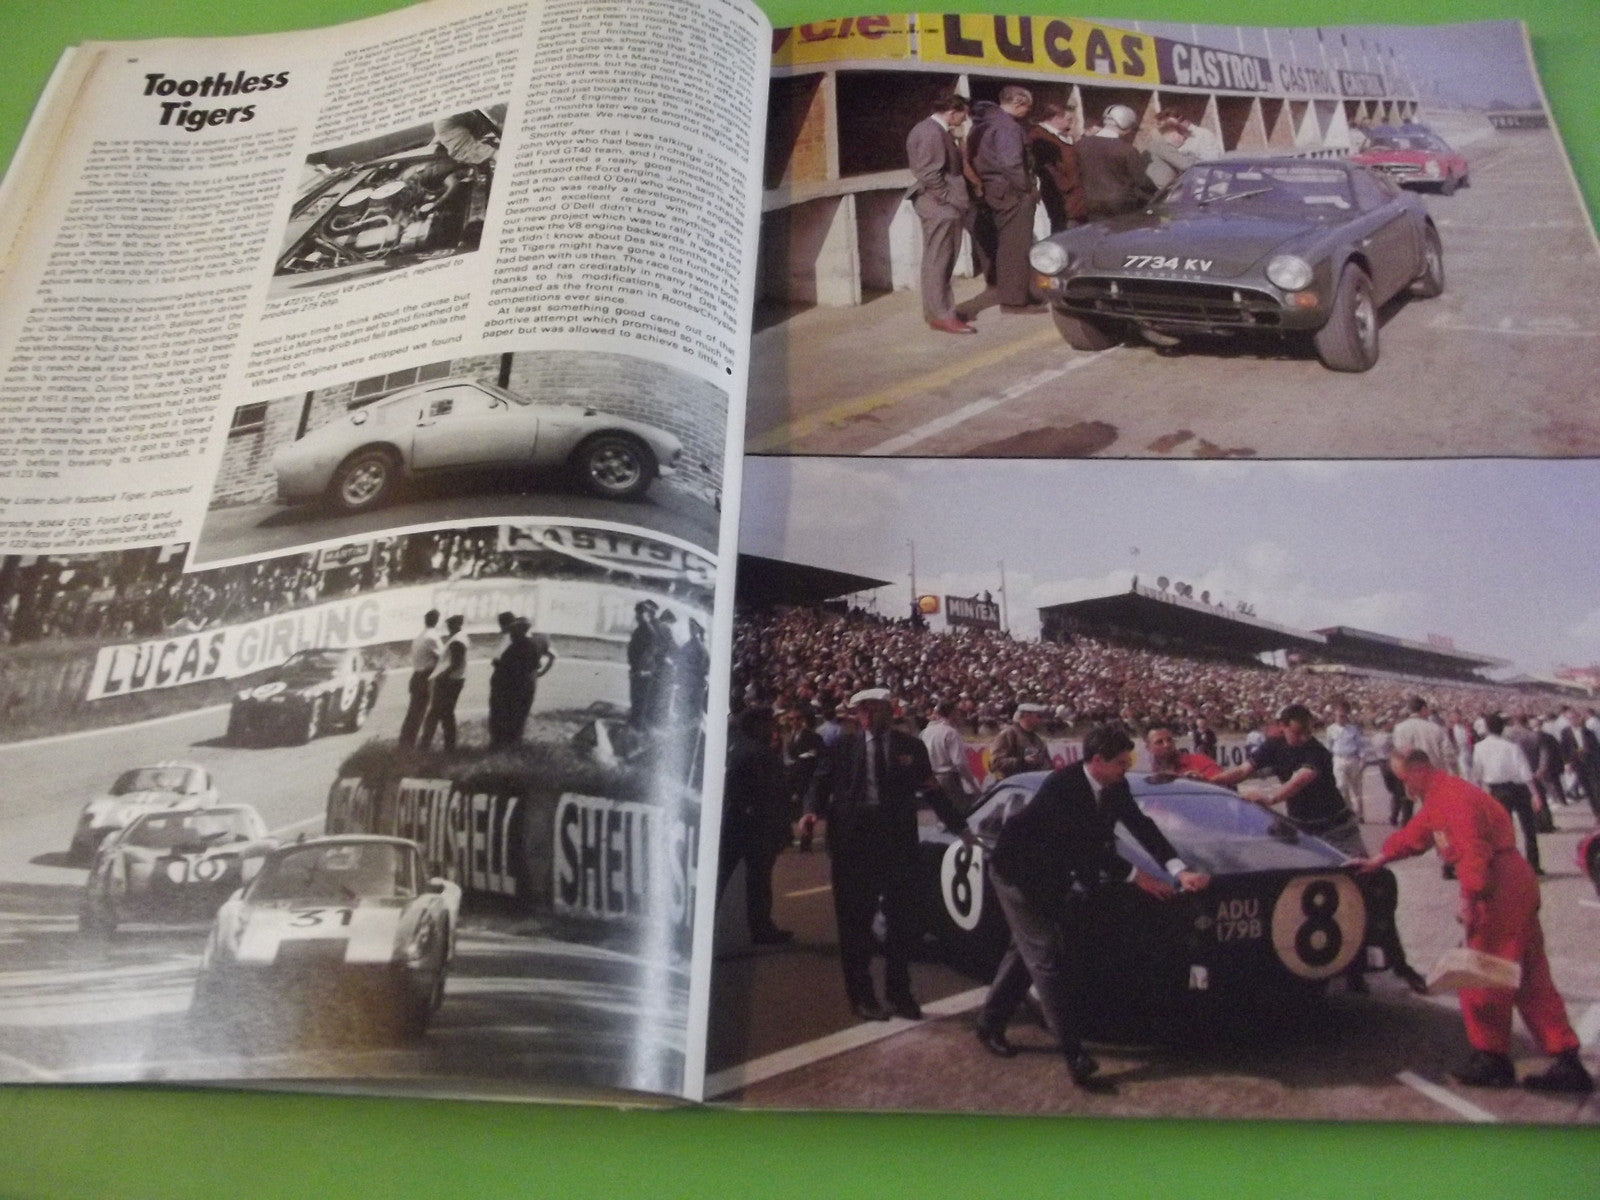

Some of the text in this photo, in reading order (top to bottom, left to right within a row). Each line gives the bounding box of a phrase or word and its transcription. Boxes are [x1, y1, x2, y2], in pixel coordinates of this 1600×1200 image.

[943, 14, 1146, 76] LUCAS
[143, 70, 290, 97] Toothless
[1172, 44, 1267, 91] CASTROL
[159, 101, 256, 132] Tigers
[529, 129, 565, 140] Shortly
[571, 128, 595, 136] after
[599, 128, 621, 136] that
[633, 132, 654, 140] was
[658, 135, 693, 151] talking
[706, 152, 727, 166] over
[356, 278, 386, 292] power
[453, 258, 464, 266] to
[493, 264, 528, 275] tamed
[531, 262, 554, 271] and
[579, 263, 636, 274] creditably
[640, 268, 651, 276] in
[654, 272, 685, 286] many
[688, 283, 715, 299] races
[495, 255, 516, 264] had
[517, 253, 545, 262] been
[547, 251, 572, 259] with
[623, 252, 644, 264] The
[645, 259, 670, 270] race
[671, 266, 694, 279] cars
[695, 275, 719, 290] were
[1121, 255, 1213, 271] 7734 KV
[487, 294, 561, 306] competitions
[489, 283, 543, 295] remained
[545, 283, 559, 291] as
[562, 282, 581, 290] the
[585, 282, 613, 291] front
[617, 286, 643, 295] man
[646, 290, 658, 299] in
[491, 275, 528, 285] thanks
[535, 273, 547, 281] to
[555, 272, 573, 280] his
[671, 287, 692, 299] and
[698, 296, 717, 311] Des
[722, 310, 737, 325] has
[284, 331, 307, 341] have
[333, 322, 344, 330] to
[345, 315, 369, 327] think
[372, 308, 400, 321] about
[402, 304, 418, 313] the
[420, 297, 450, 309] cause
[452, 292, 471, 302] but
[497, 303, 735, 355] At least something good came out of that
[481, 328, 513, 339] paper
[517, 326, 537, 334] but
[568, 325, 615, 335] allowed
[619, 329, 631, 338] to
[635, 332, 678, 349] achieve
[681, 345, 695, 355] so
[484, 316, 530, 327] abortive
[533, 314, 578, 323] attempt
[582, 315, 618, 324] which
[621, 319, 677, 337] promised
[679, 333, 692, 343] so
[694, 339, 722, 357] much
[251, 333, 463, 387] When the engines were stripped we found
[949, 599, 998, 622] MINTEX
[104, 632, 225, 694] LUCAS
[235, 599, 381, 670] GIRLING
[951, 845, 972, 918] 8
[298, 908, 352, 929] 31
[1216, 899, 1258, 921] ADU
[1295, 879, 1342, 967] 8
[1217, 920, 1261, 942] 179B
